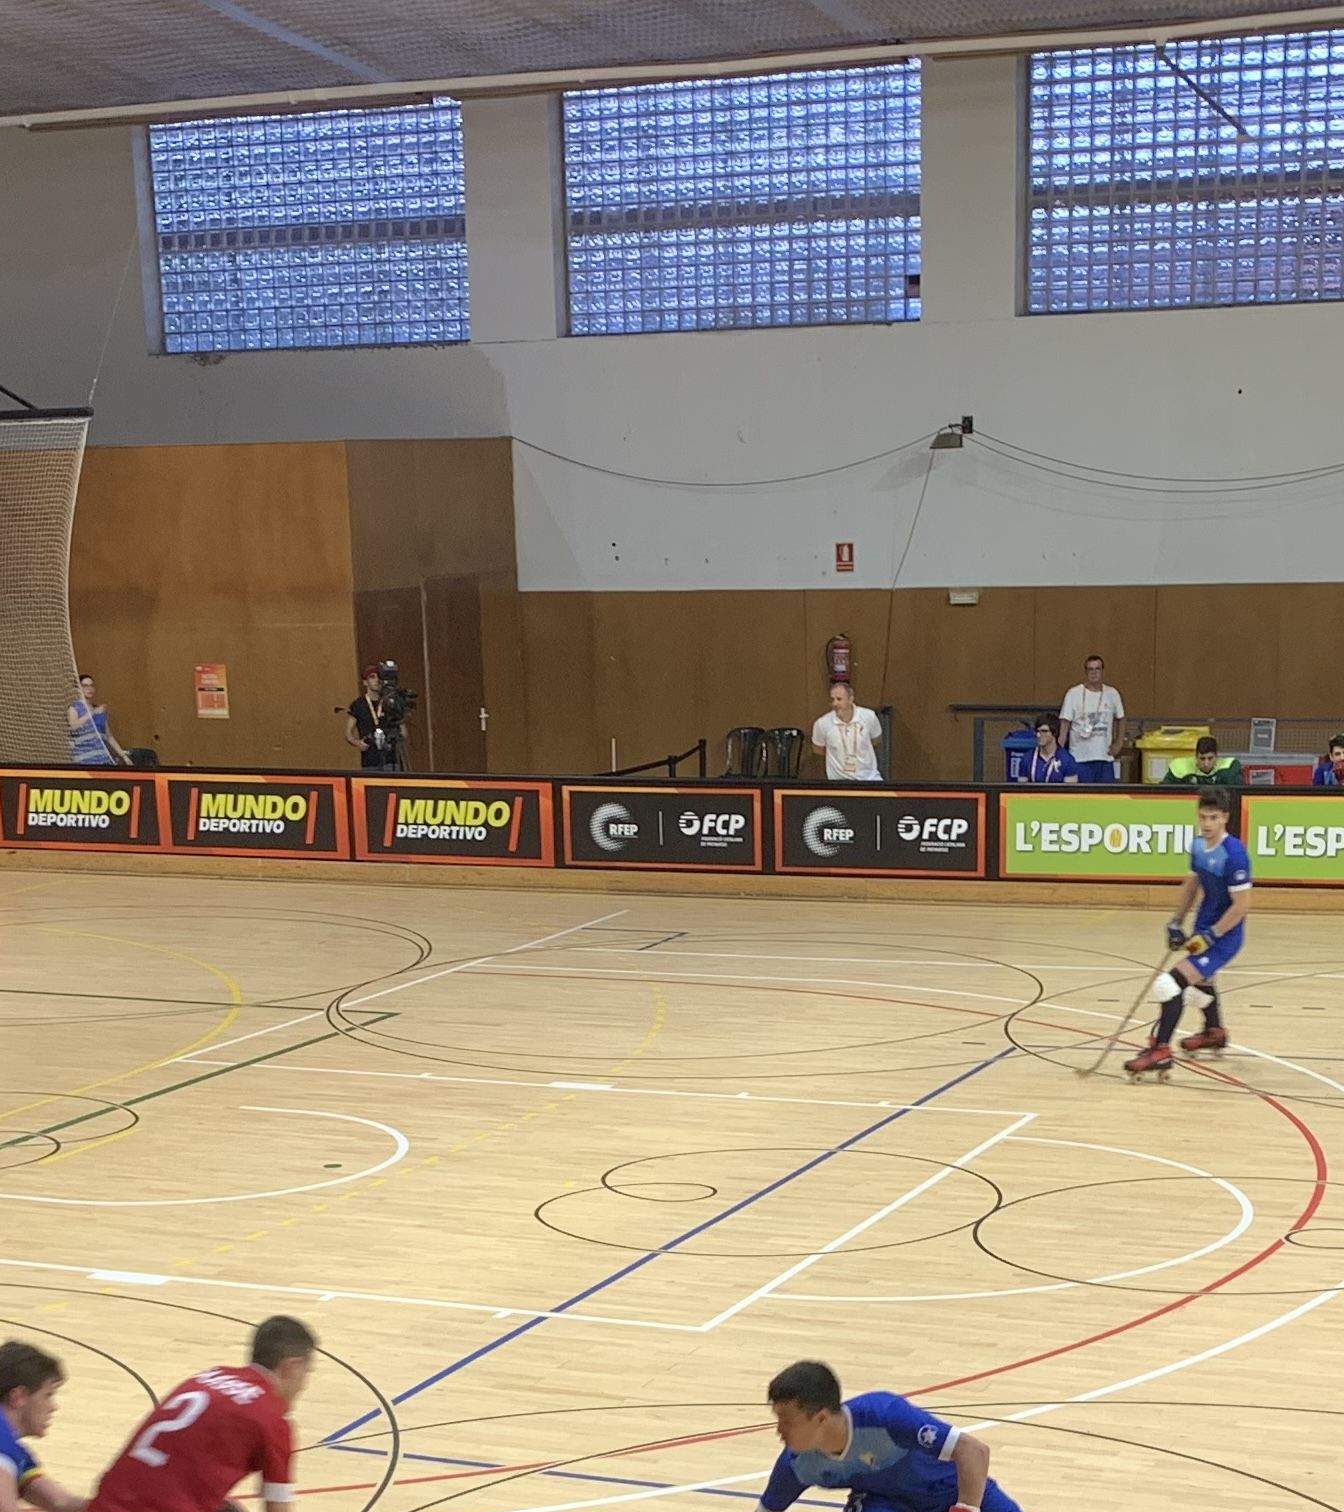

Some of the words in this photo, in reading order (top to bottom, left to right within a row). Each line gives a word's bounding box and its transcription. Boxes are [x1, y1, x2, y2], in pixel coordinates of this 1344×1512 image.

[29, 788, 131, 815] MUNDO
[199, 793, 307, 822] MUNDO
[27, 813, 110, 829] DEPORTIVO
[397, 798, 511, 828] MUNDO
[701, 813, 746, 835] FCP
[198, 818, 286, 834] DEPORTIVO
[395, 823, 488, 841] DEPORTIVO
[609, 822, 640, 837] RFEP
[822, 828, 854, 842] RFEP
[920, 818, 969, 840] FCP
[129, 1389, 212, 1468] 2
